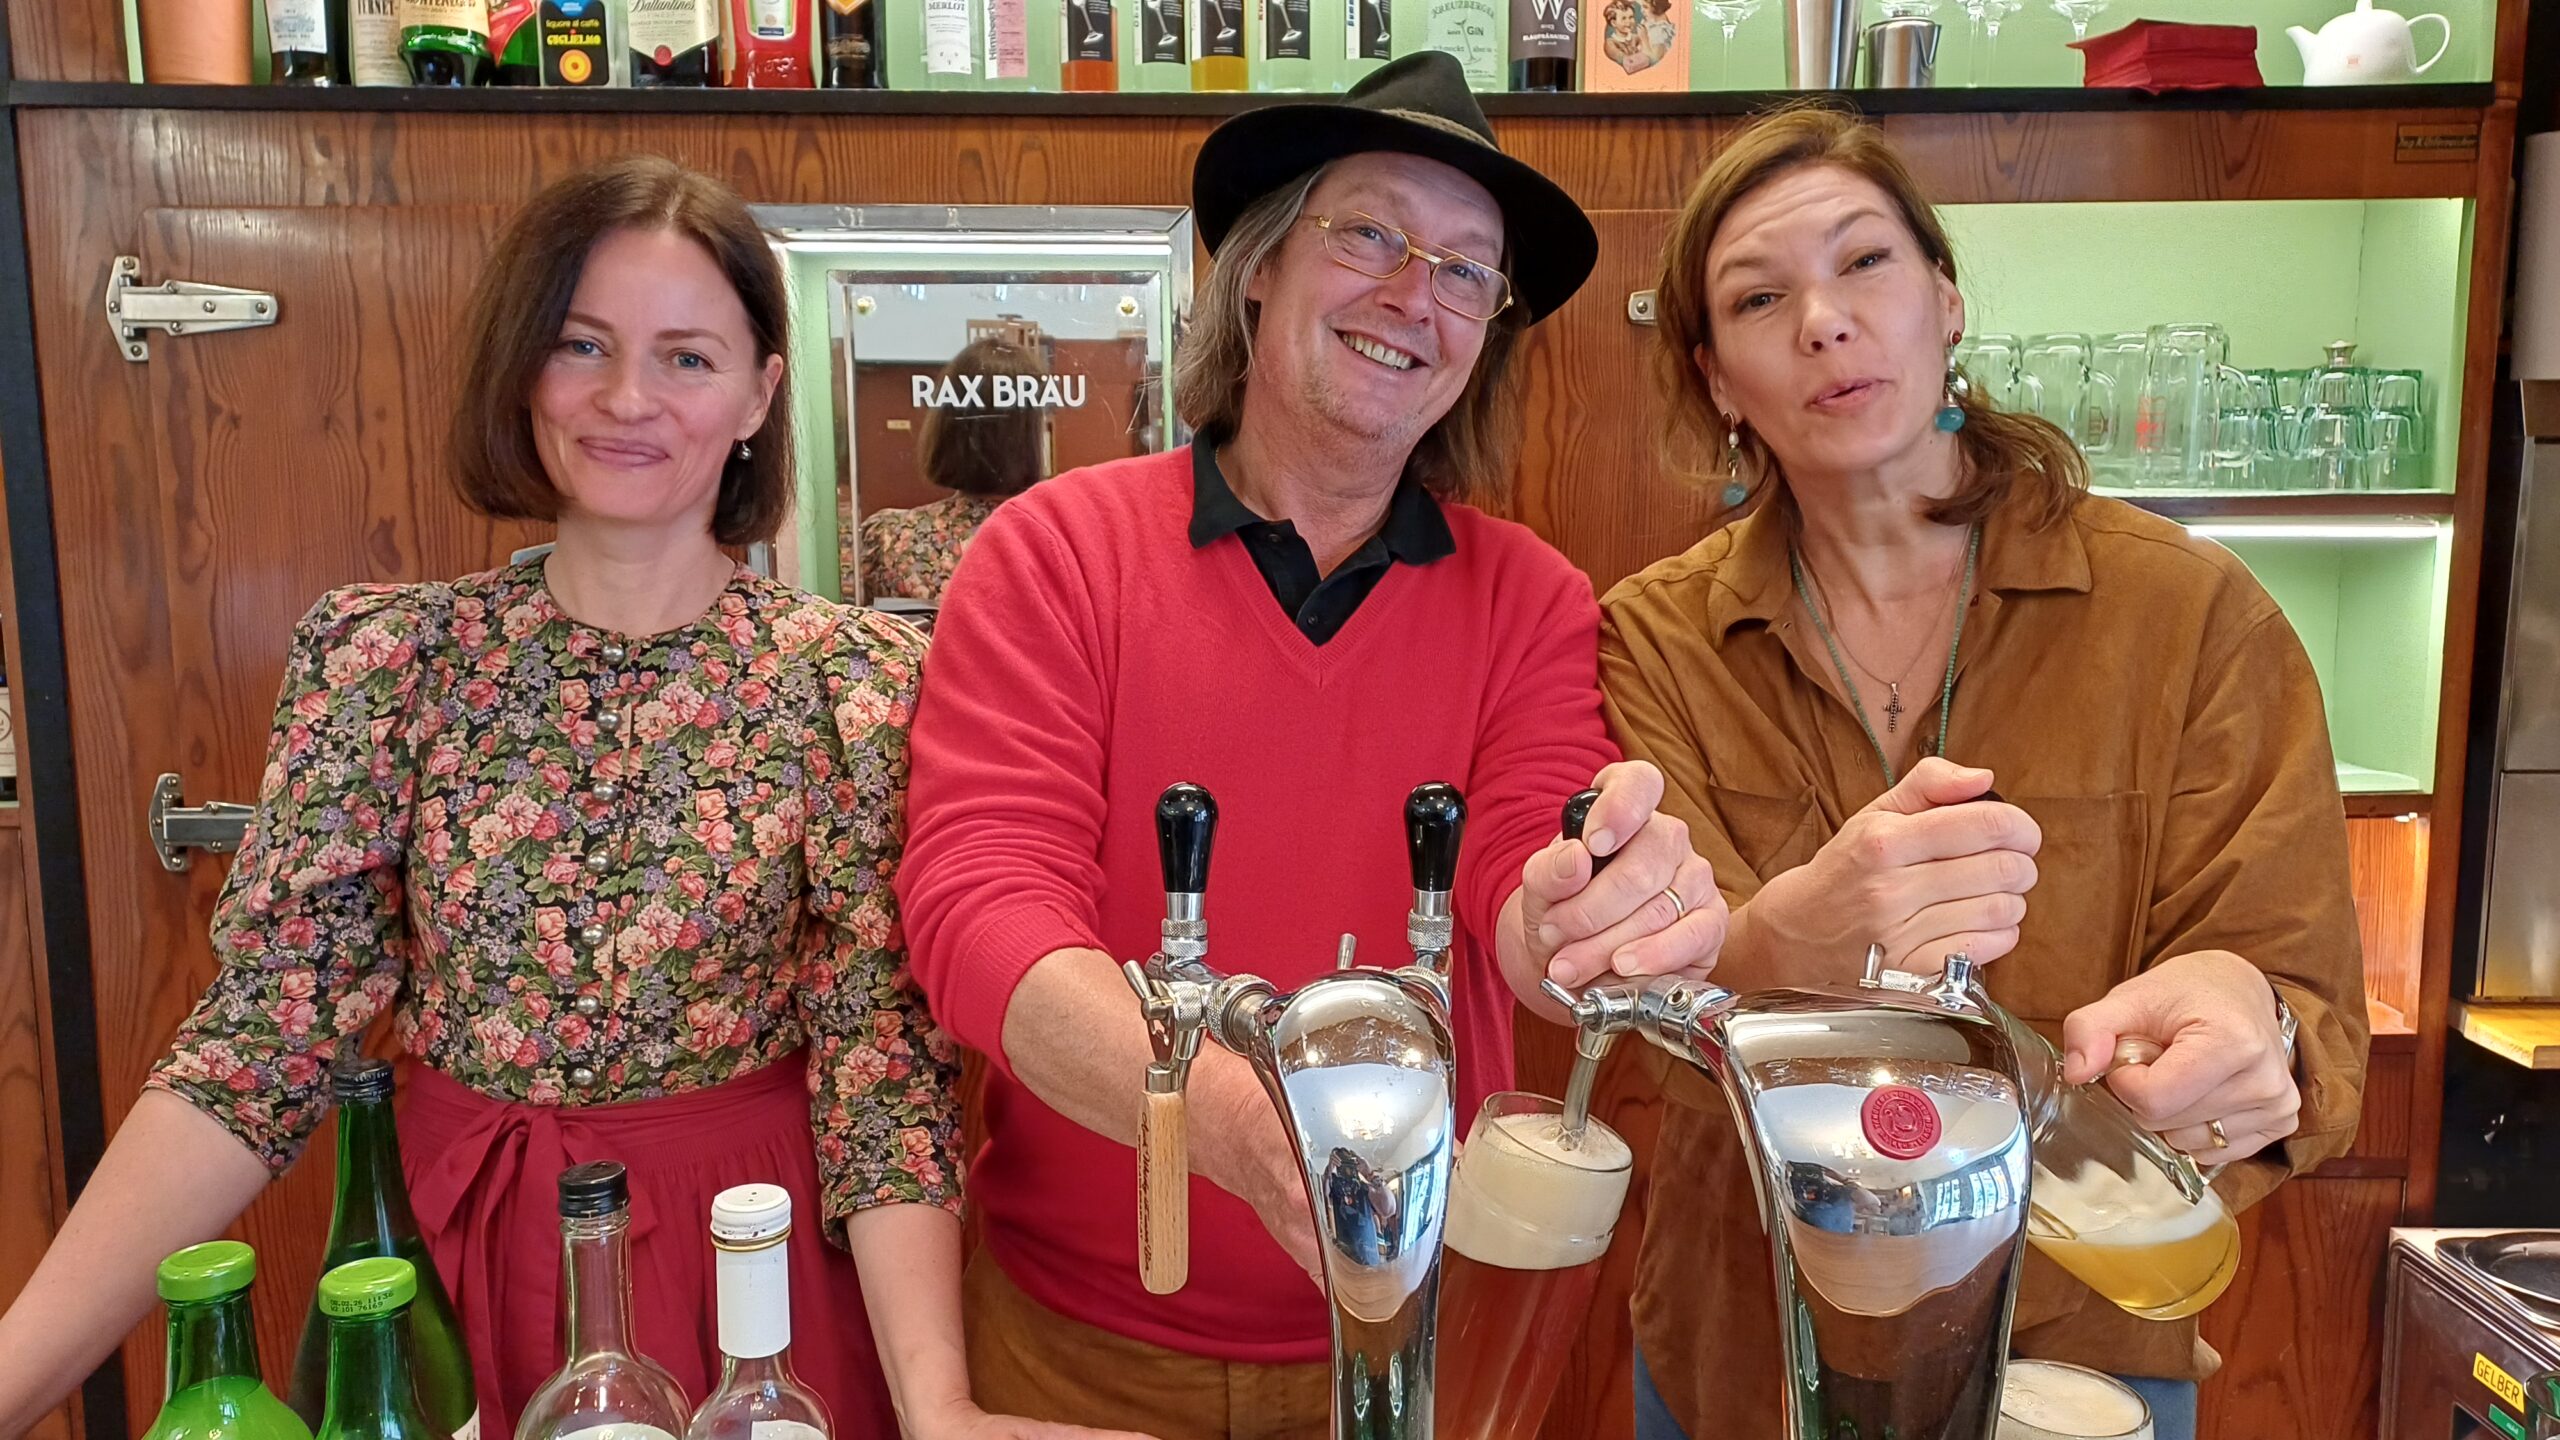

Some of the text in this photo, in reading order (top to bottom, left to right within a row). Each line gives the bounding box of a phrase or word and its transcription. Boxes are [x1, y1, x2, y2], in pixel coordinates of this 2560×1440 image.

[1466, 25, 1485, 36] GIN
[911, 374, 1087, 409] RAX BRÄU
[2475, 1359, 2520, 1404] GELBER
